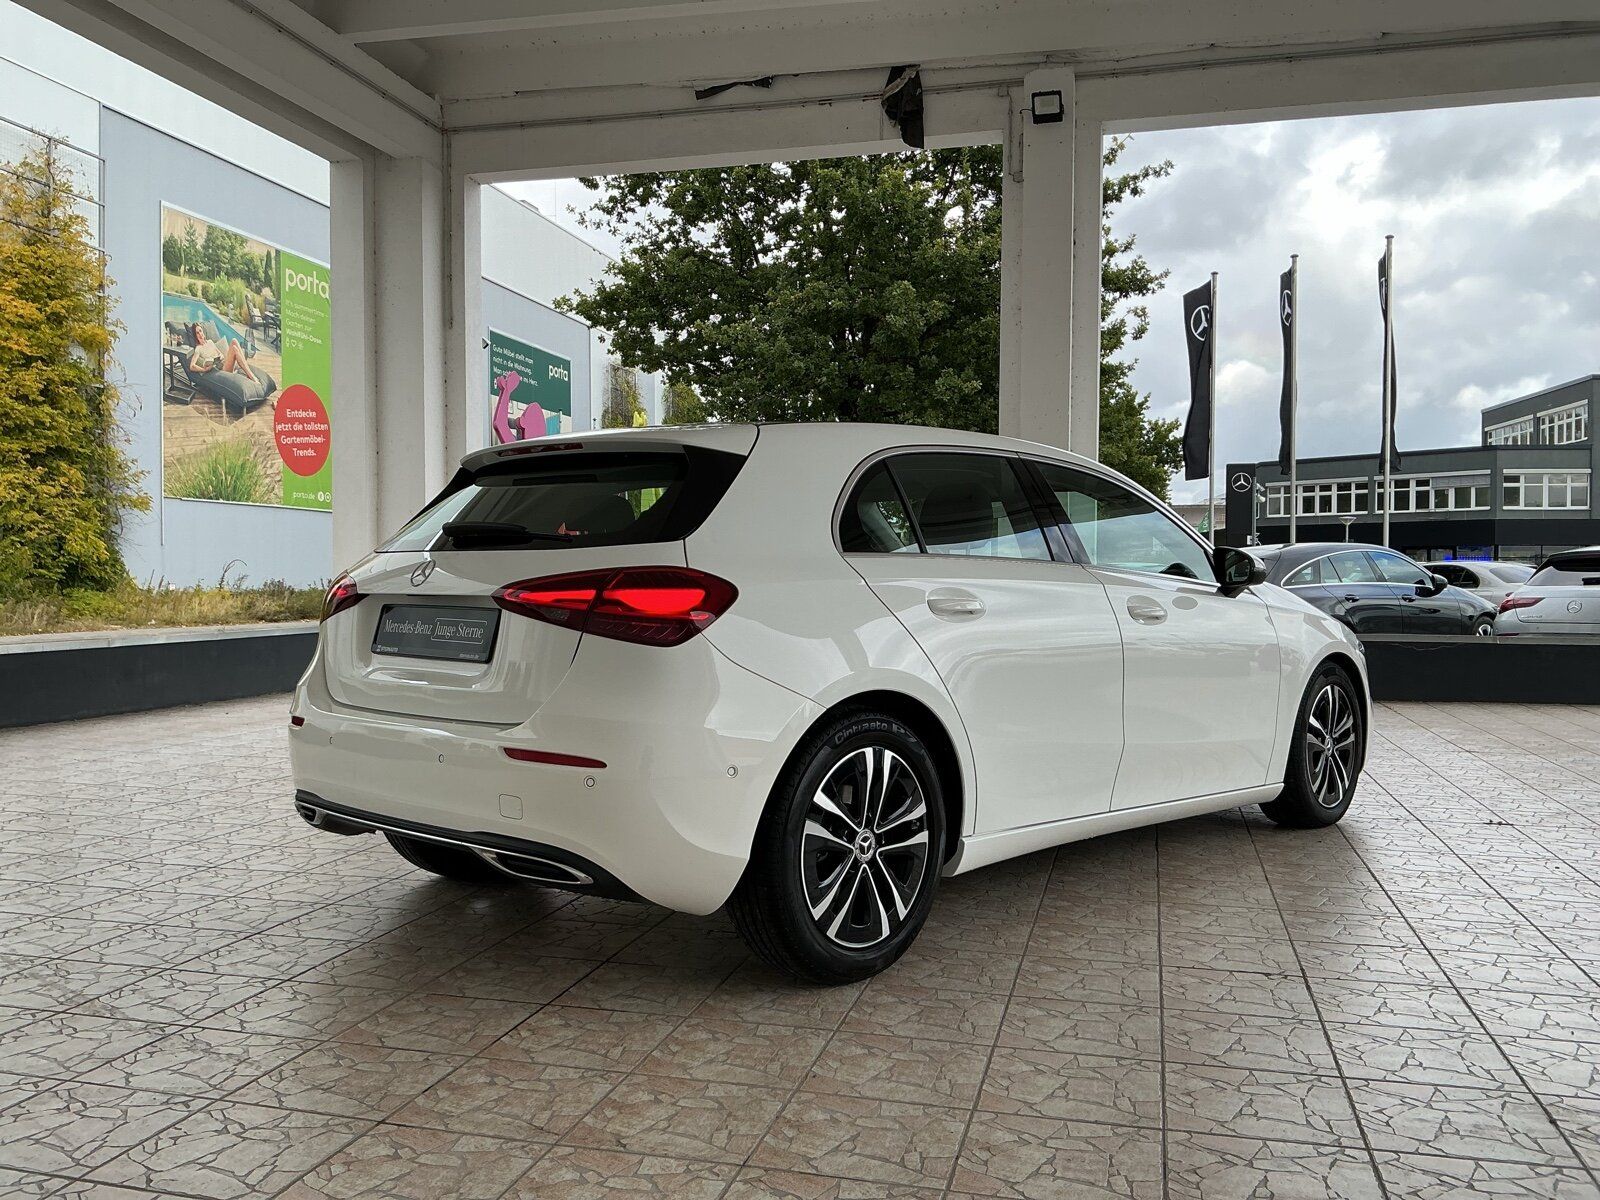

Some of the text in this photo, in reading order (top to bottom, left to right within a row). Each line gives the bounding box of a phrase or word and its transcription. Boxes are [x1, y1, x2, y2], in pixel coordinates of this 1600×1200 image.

[285, 268, 330, 299] porta
[548, 365, 568, 381] porta
[286, 409, 317, 418] Entdecke
[275, 423, 329, 433] jetzt die tollsten
[280, 435, 326, 445] Gartenmöbel-
[292, 448, 317, 457] Trends.
[384, 619, 484, 639] Mercedes-Benz Junge Sterne
